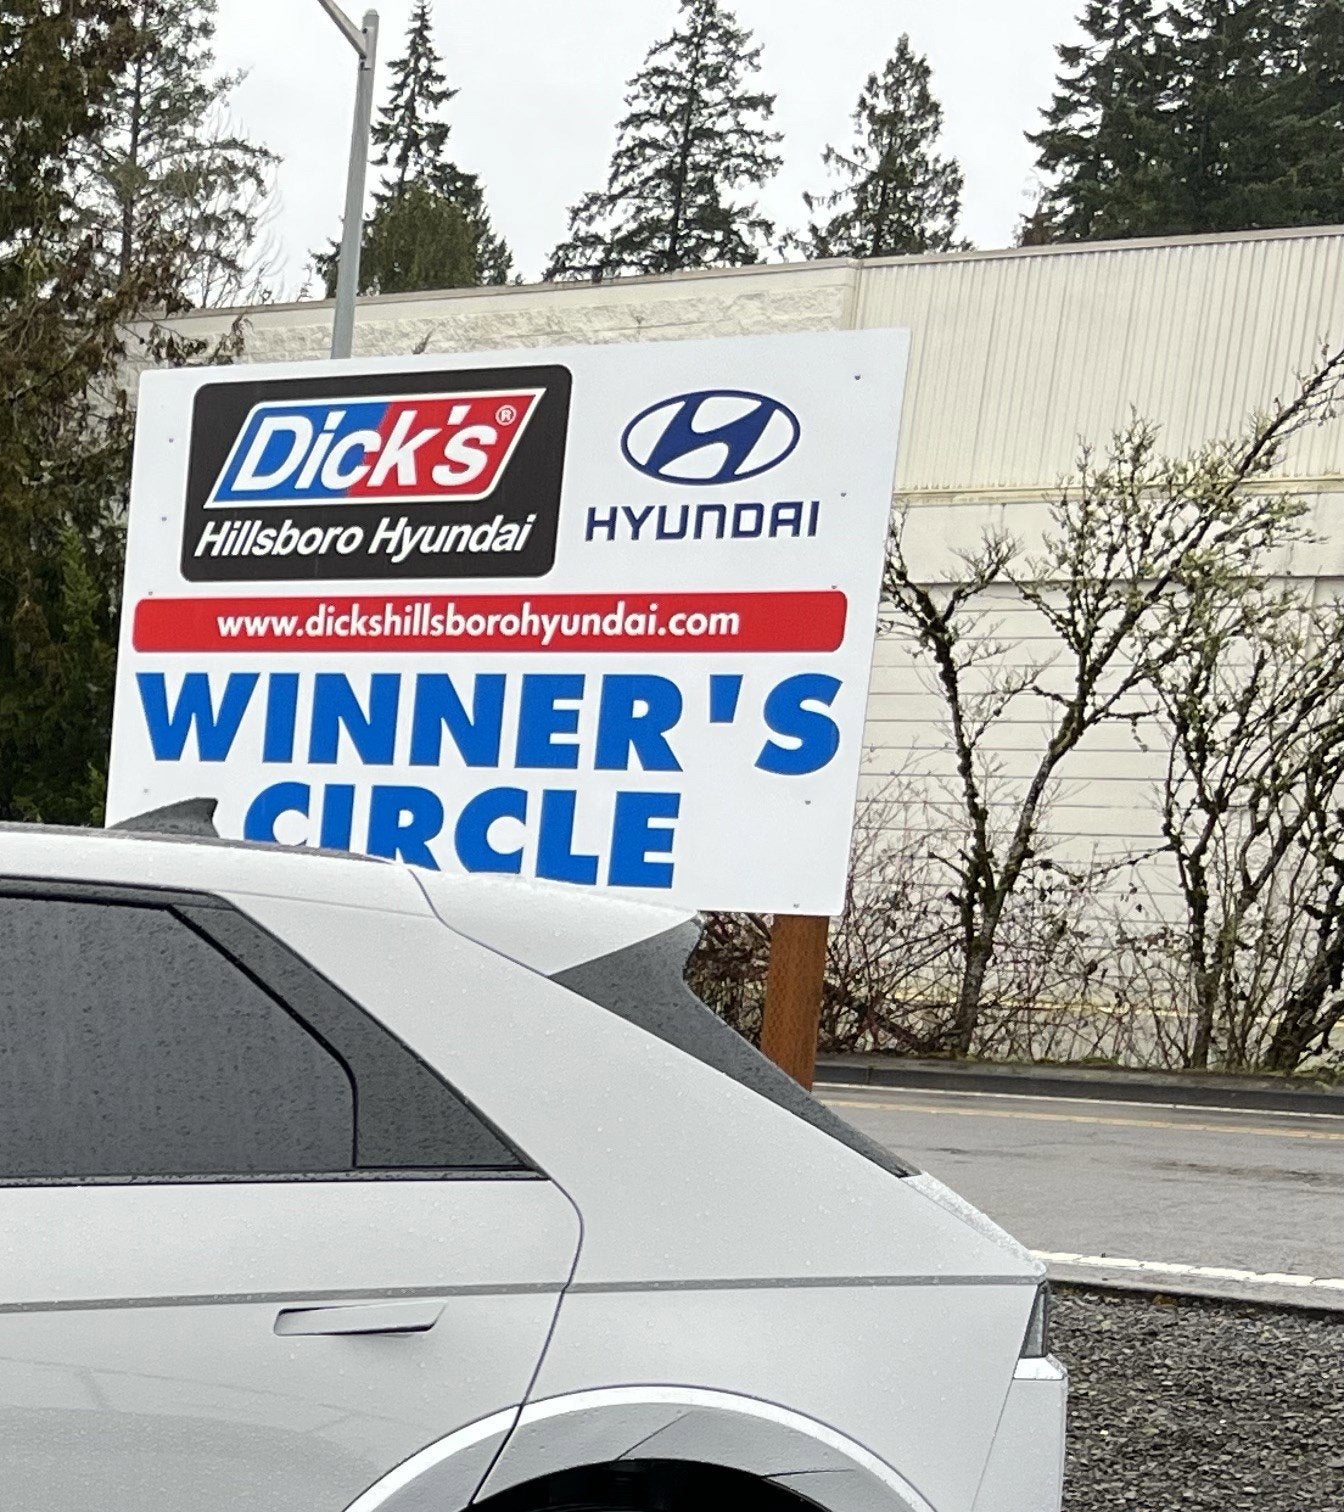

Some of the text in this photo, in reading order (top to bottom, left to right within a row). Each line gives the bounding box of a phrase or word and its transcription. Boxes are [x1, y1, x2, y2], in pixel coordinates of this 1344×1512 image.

[229, 404, 499, 492] Dick's
[193, 512, 538, 562] Hillsboro Hyundai
[585, 501, 820, 541] HYUNDAI
[217, 601, 741, 646] www.dickshillsborohyundai.com
[135, 672, 843, 776] WINNER'S
[243, 781, 682, 889] CIRCLE
